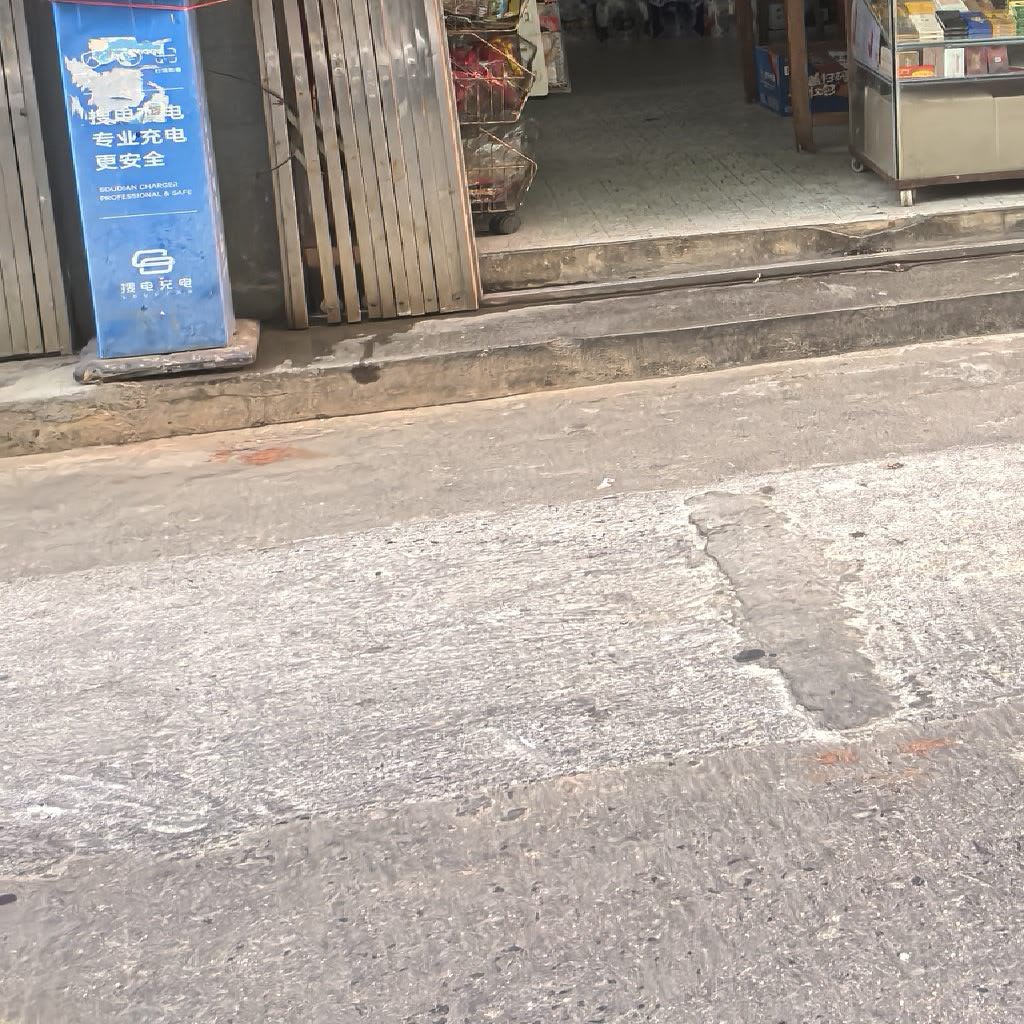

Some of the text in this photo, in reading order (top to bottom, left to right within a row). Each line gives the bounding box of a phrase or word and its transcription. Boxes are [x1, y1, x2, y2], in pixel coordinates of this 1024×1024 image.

[92, 127, 188, 147] 专业充电
[95, 151, 166, 172] 更安全
[139, 181, 178, 190] CHARGER
[99, 192, 162, 201] PROFESSIONAL
